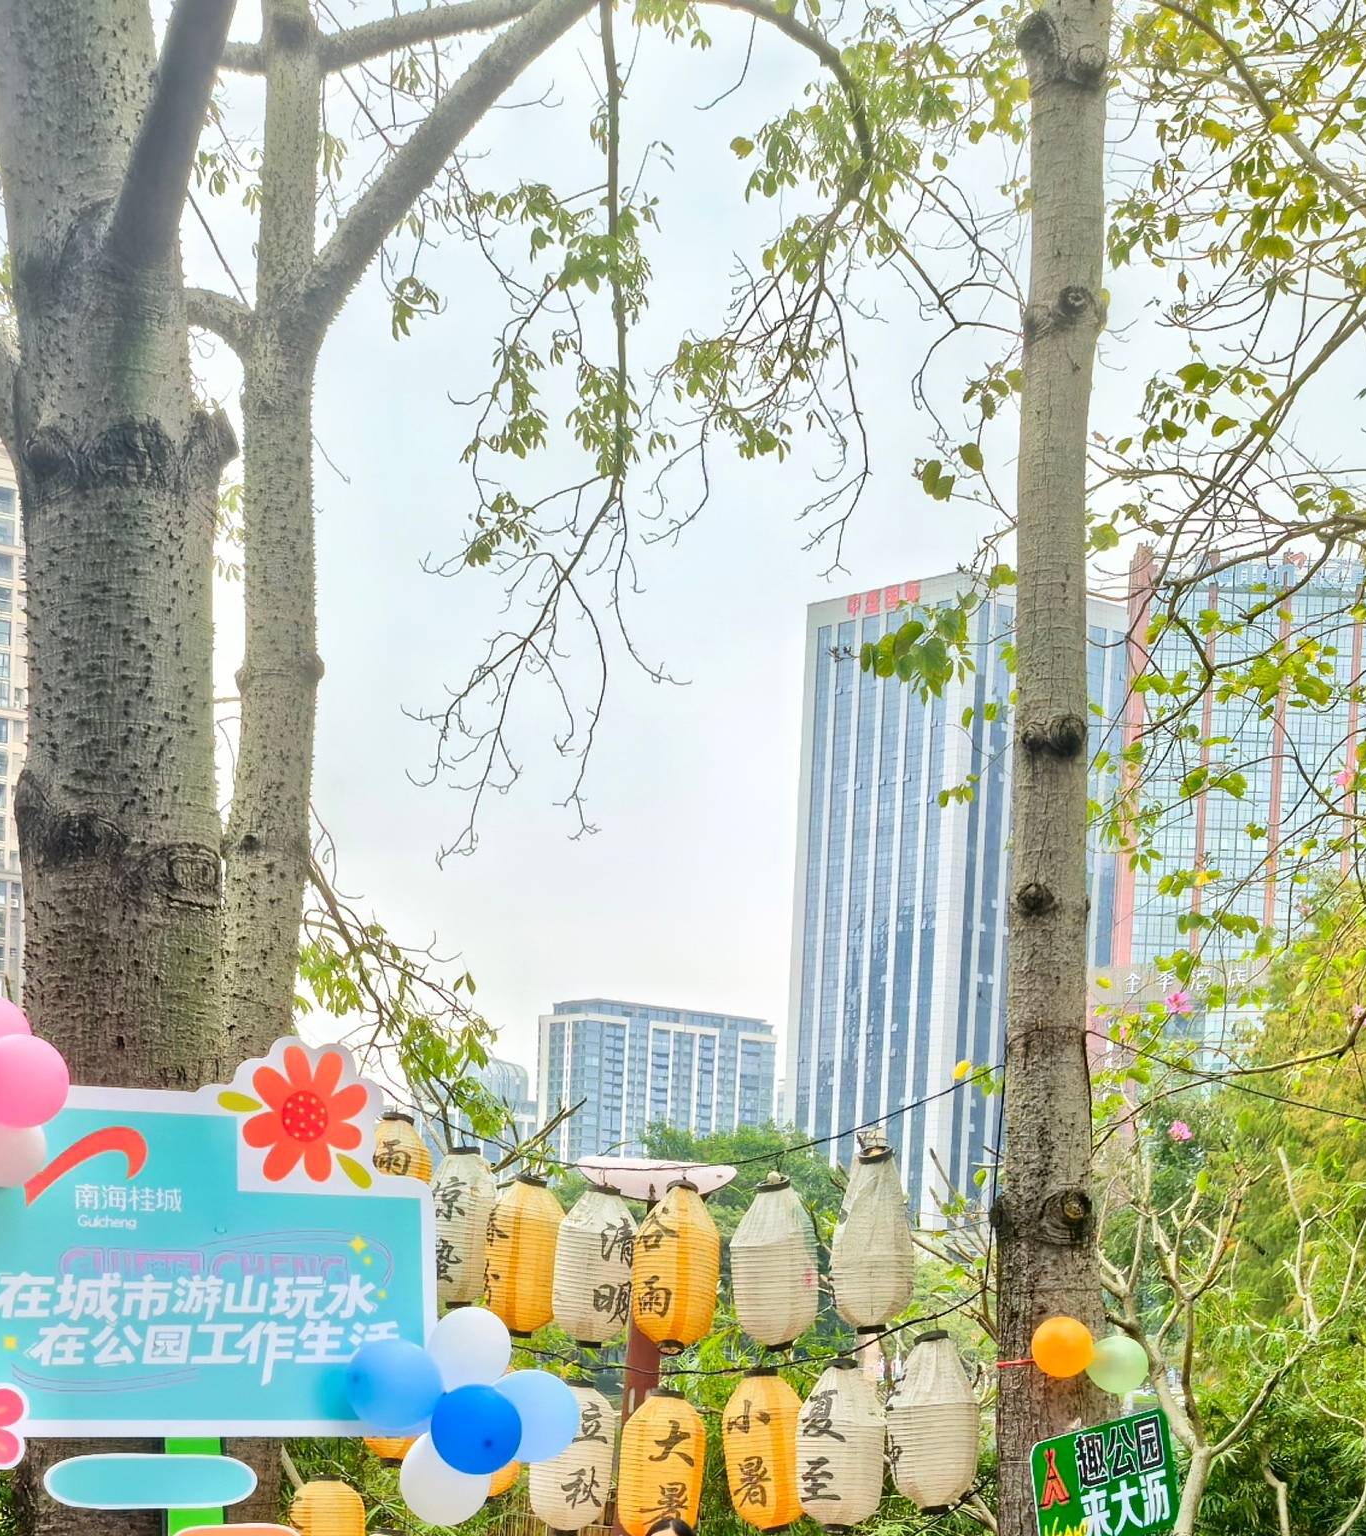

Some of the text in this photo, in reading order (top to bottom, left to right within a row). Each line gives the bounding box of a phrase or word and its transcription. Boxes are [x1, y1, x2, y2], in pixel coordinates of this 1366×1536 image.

[75, 1184, 183, 1213] 南海桂城
[77, 1214, 137, 1230] Guicheng
[593, 1216, 636, 1326] 清明
[636, 1206, 681, 1318] 谷雨
[561, 1401, 608, 1510] 立秋
[639, 1419, 696, 1527] 大暑
[726, 1400, 772, 1508] 小暑
[801, 1389, 847, 1503] 夏至
[1074, 1415, 1165, 1491] 趣公园
